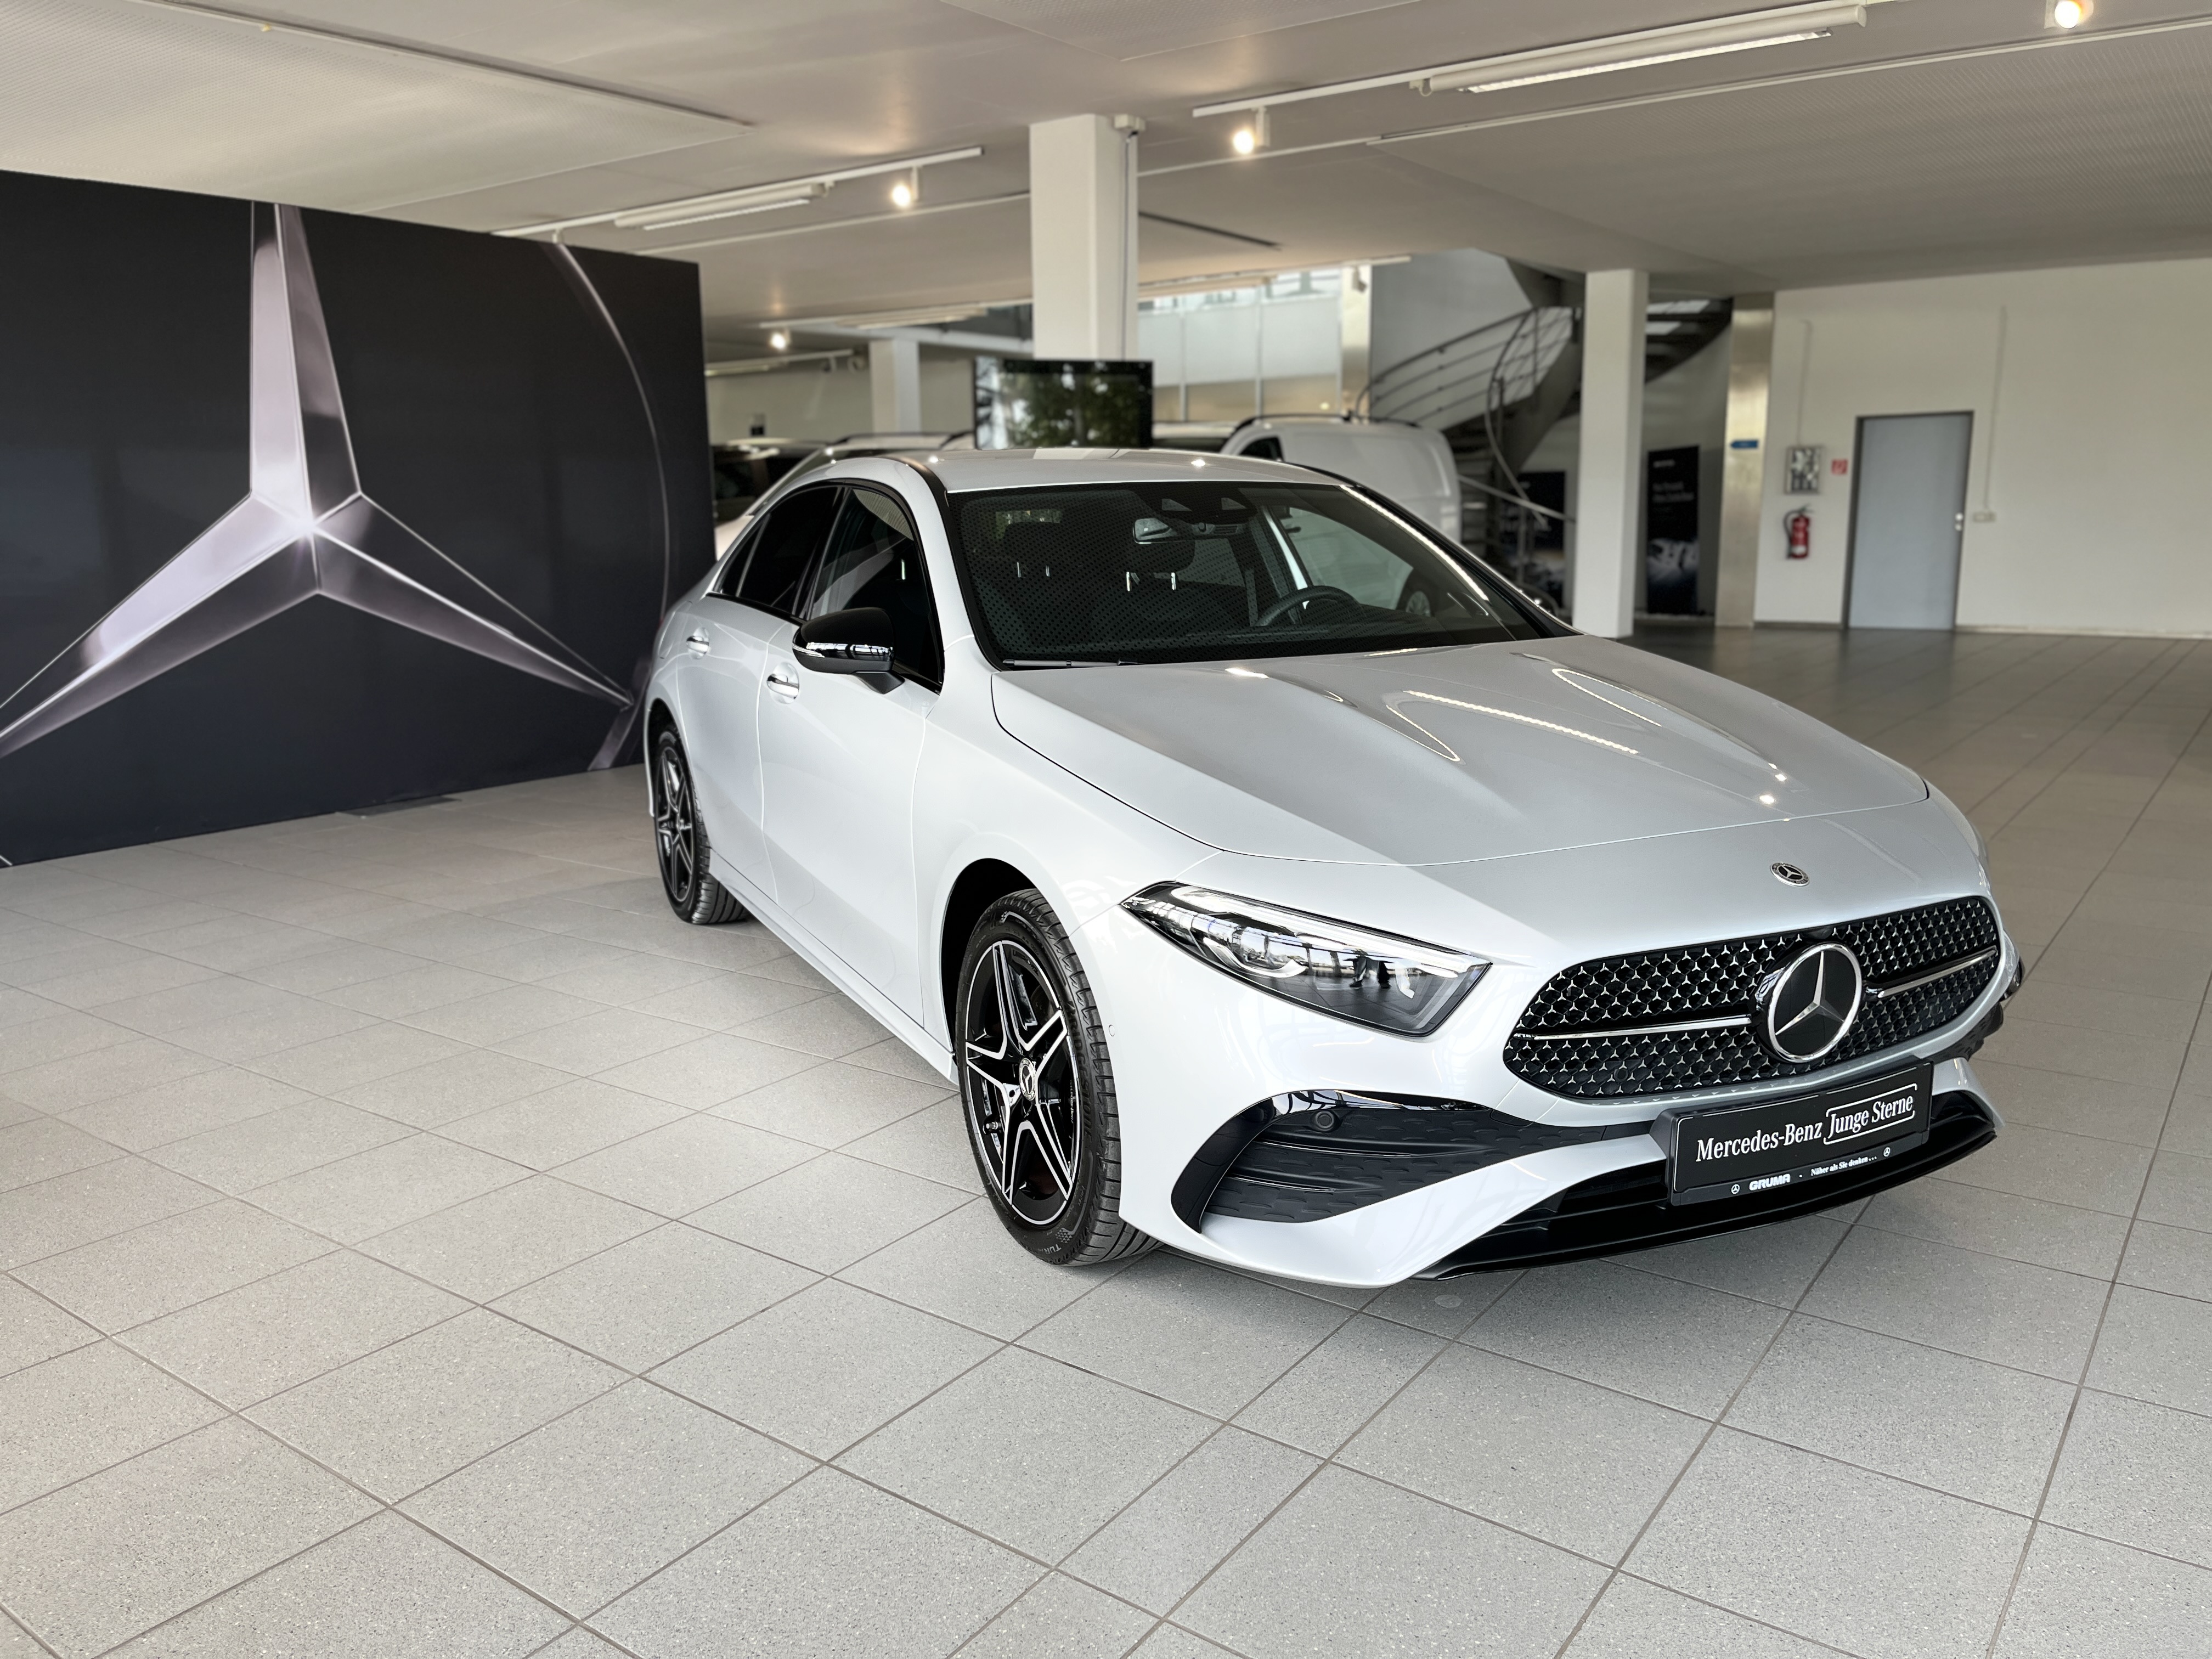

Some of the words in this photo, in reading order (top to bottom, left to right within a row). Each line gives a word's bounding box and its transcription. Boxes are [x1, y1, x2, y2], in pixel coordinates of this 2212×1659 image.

[1827, 1110, 1869, 1139] Junge
[1871, 1096, 1914, 1124] Sterne
[1695, 1120, 1822, 1163] Mercedes-Benz
[1749, 1173, 1790, 1190] GRUMA
[1810, 1167, 1829, 1176] Näher
[1829, 1164, 1838, 1172] als
[1838, 1161, 1848, 1169] Sie
